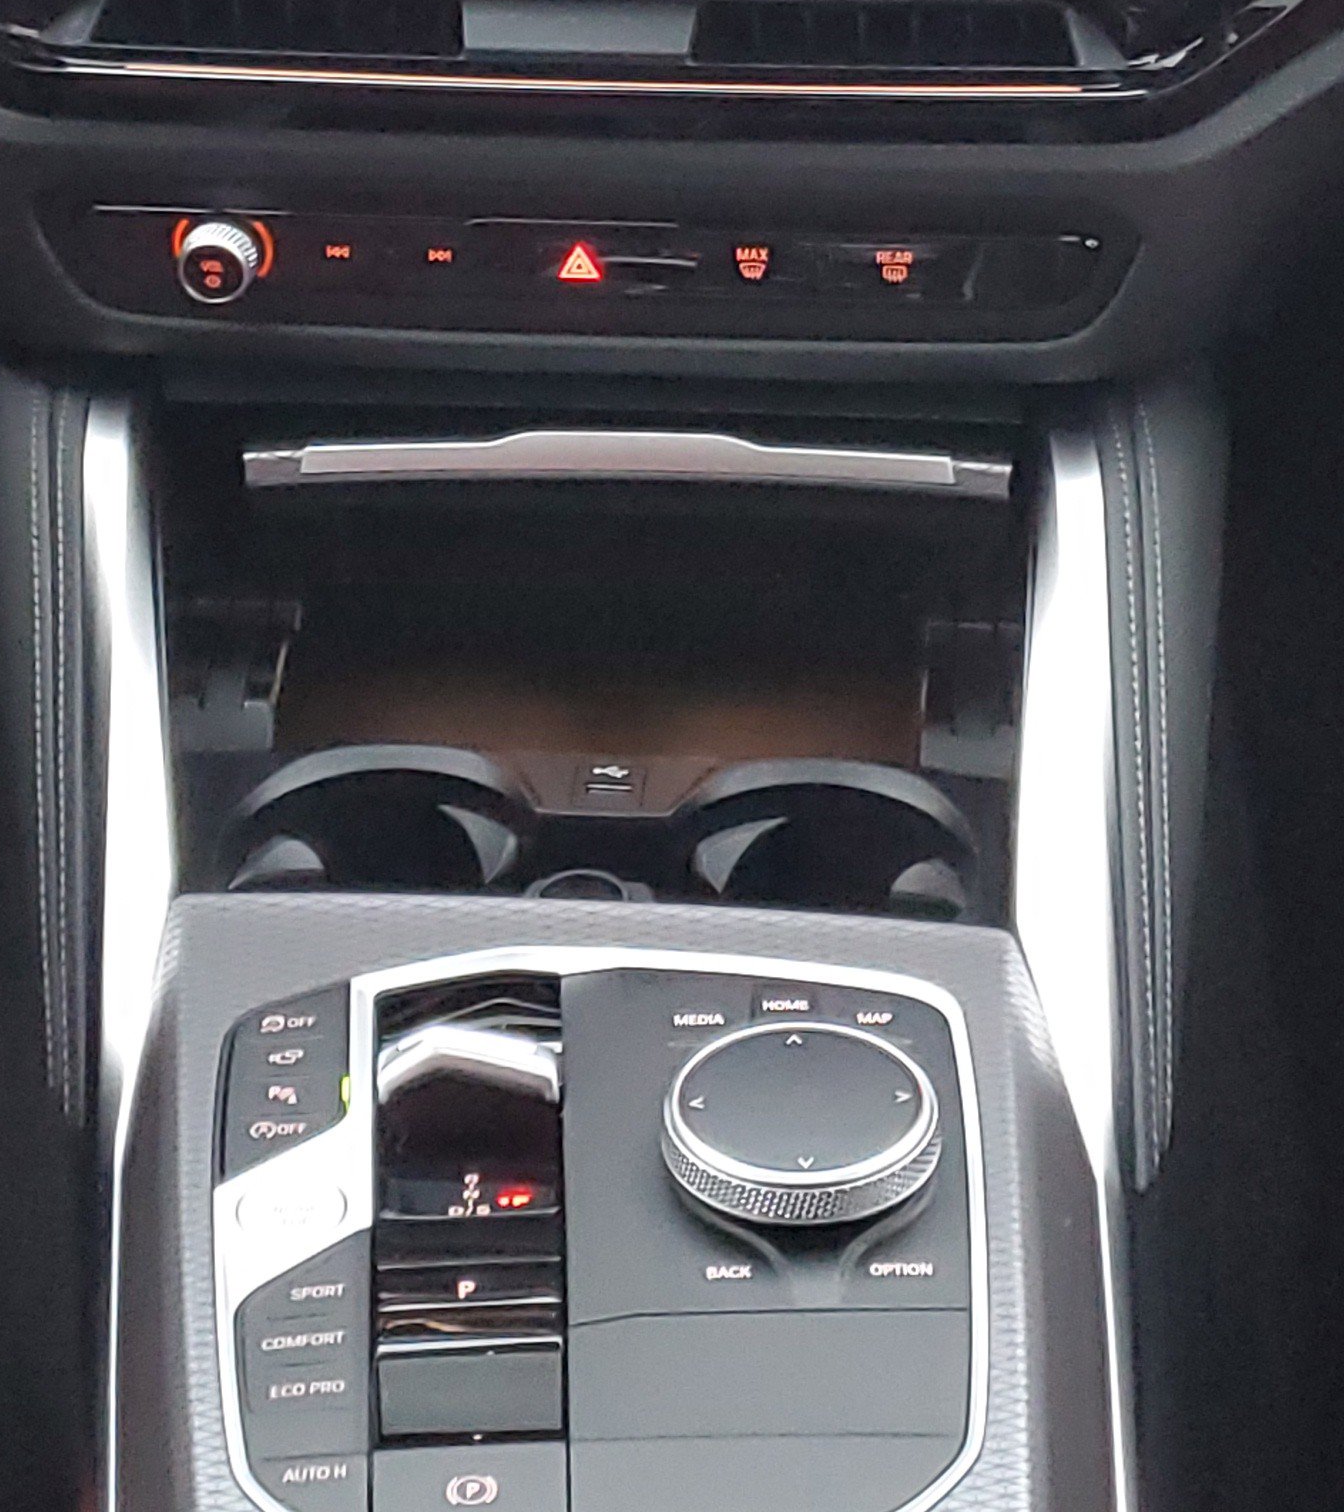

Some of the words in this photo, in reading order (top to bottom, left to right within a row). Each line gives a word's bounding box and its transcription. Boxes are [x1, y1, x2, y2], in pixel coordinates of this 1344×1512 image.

[735, 246, 769, 262] MAX
[875, 250, 914, 264] REAR
[762, 999, 809, 1012] HOME
[287, 1016, 316, 1028] OFF
[673, 1013, 725, 1027] MEDIA
[857, 1011, 893, 1025] MAP
[277, 1122, 307, 1135] OFF
[706, 1266, 752, 1279] BACK
[869, 1263, 933, 1277] OPTION
[290, 1283, 345, 1302] SPORT
[457, 1280, 476, 1299] P
[261, 1331, 345, 1351] COMFORT
[309, 1379, 345, 1396] PRO
[282, 1466, 330, 1484] AUTO
[332, 1464, 347, 1479] H
